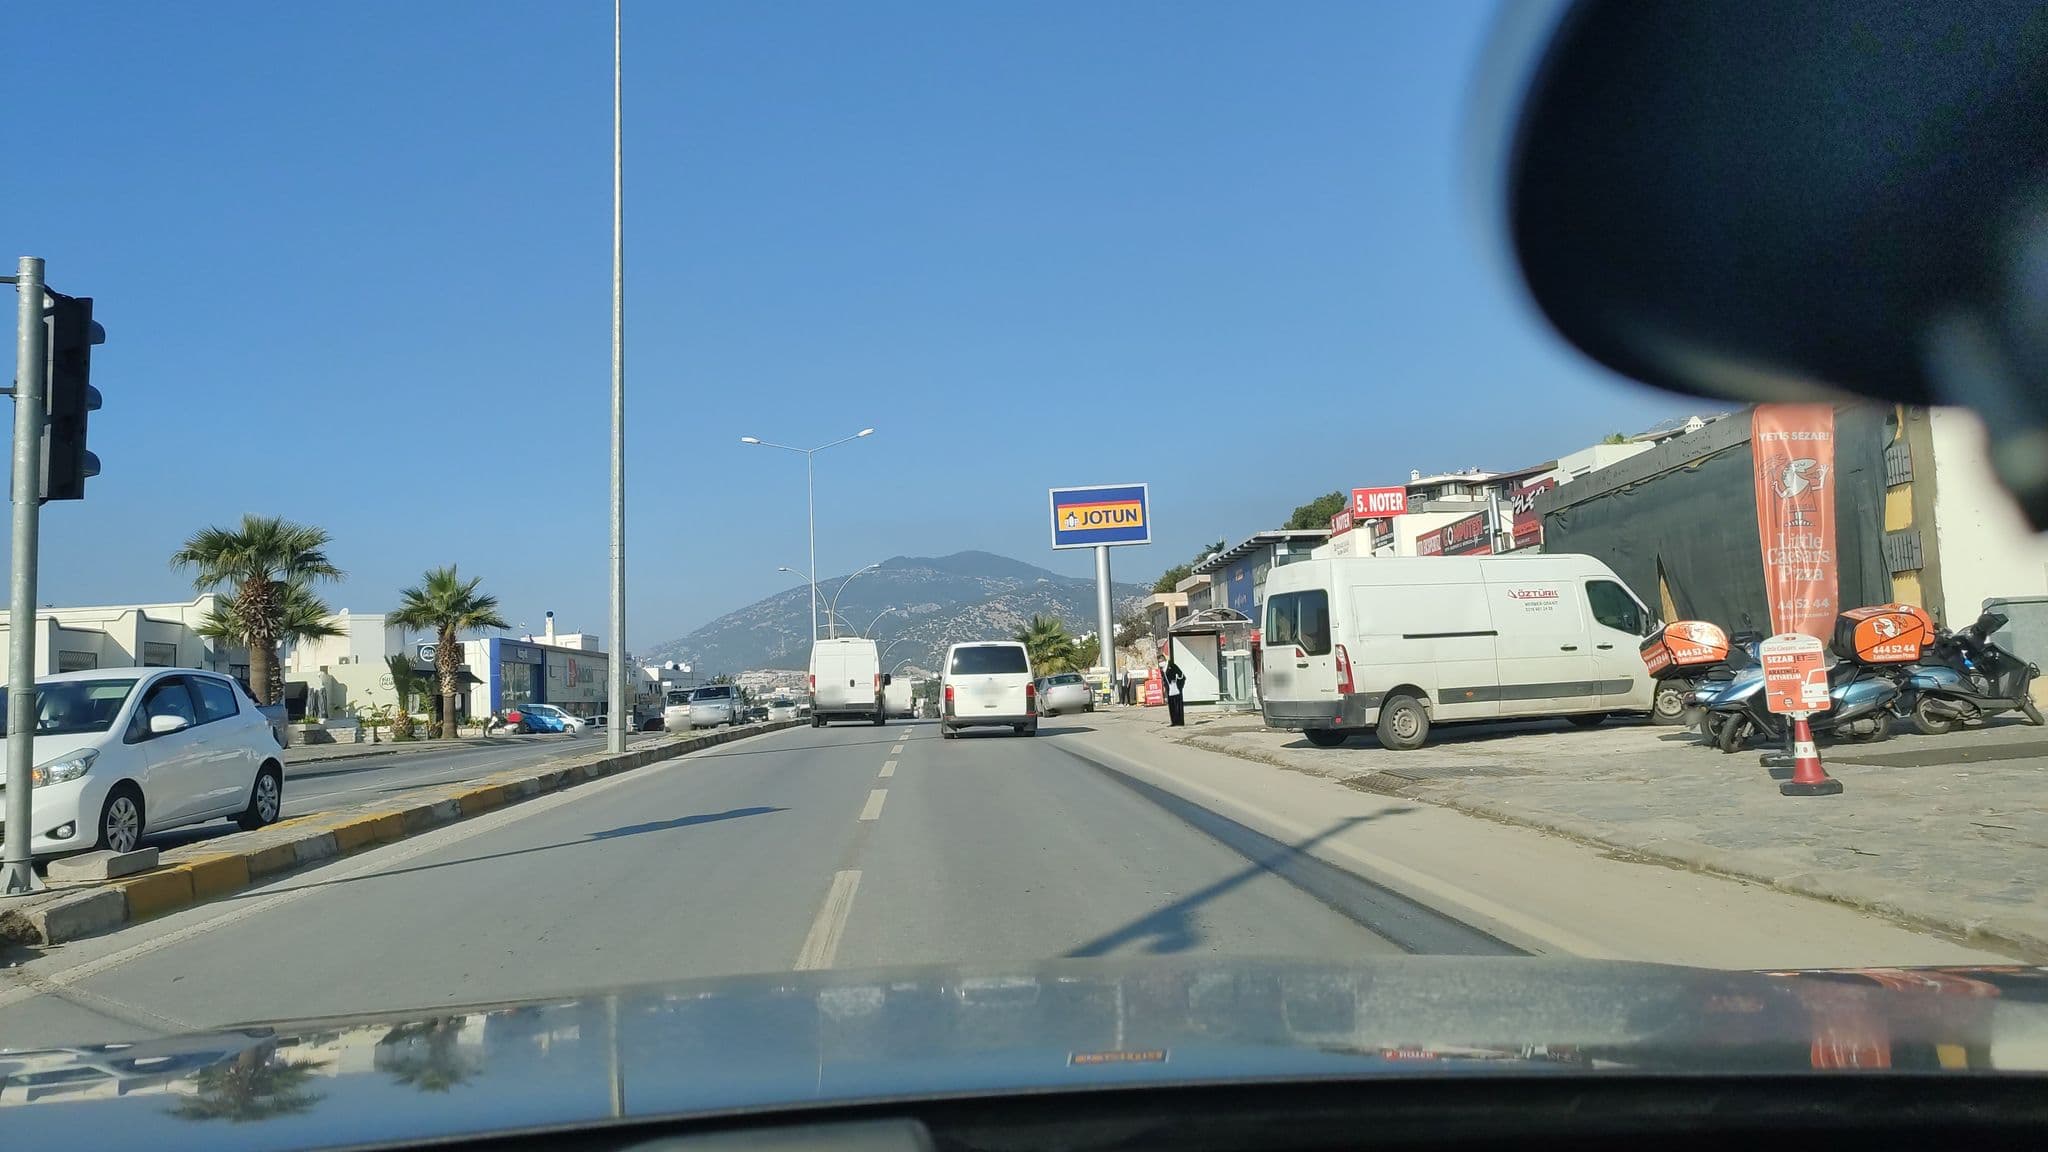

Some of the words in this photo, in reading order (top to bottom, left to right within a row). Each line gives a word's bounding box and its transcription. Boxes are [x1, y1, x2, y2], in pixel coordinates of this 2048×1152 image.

[1356, 494, 1368, 513] 5.
[1369, 492, 1404, 512] NOTER
[1082, 508, 1138, 526] JOTUN
[1778, 531, 1822, 550] Little
[1767, 548, 1831, 565] Caesars
[1779, 564, 1824, 583] Pizza
[1813, 597, 1831, 608] 44
[1677, 648, 1692, 658] 444
[1692, 648, 1702, 656] 52
[1702, 647, 1713, 655] 44
[1873, 645, 1890, 654] 444
[1892, 645, 1902, 653] 52
[1903, 644, 1915, 652] 44
